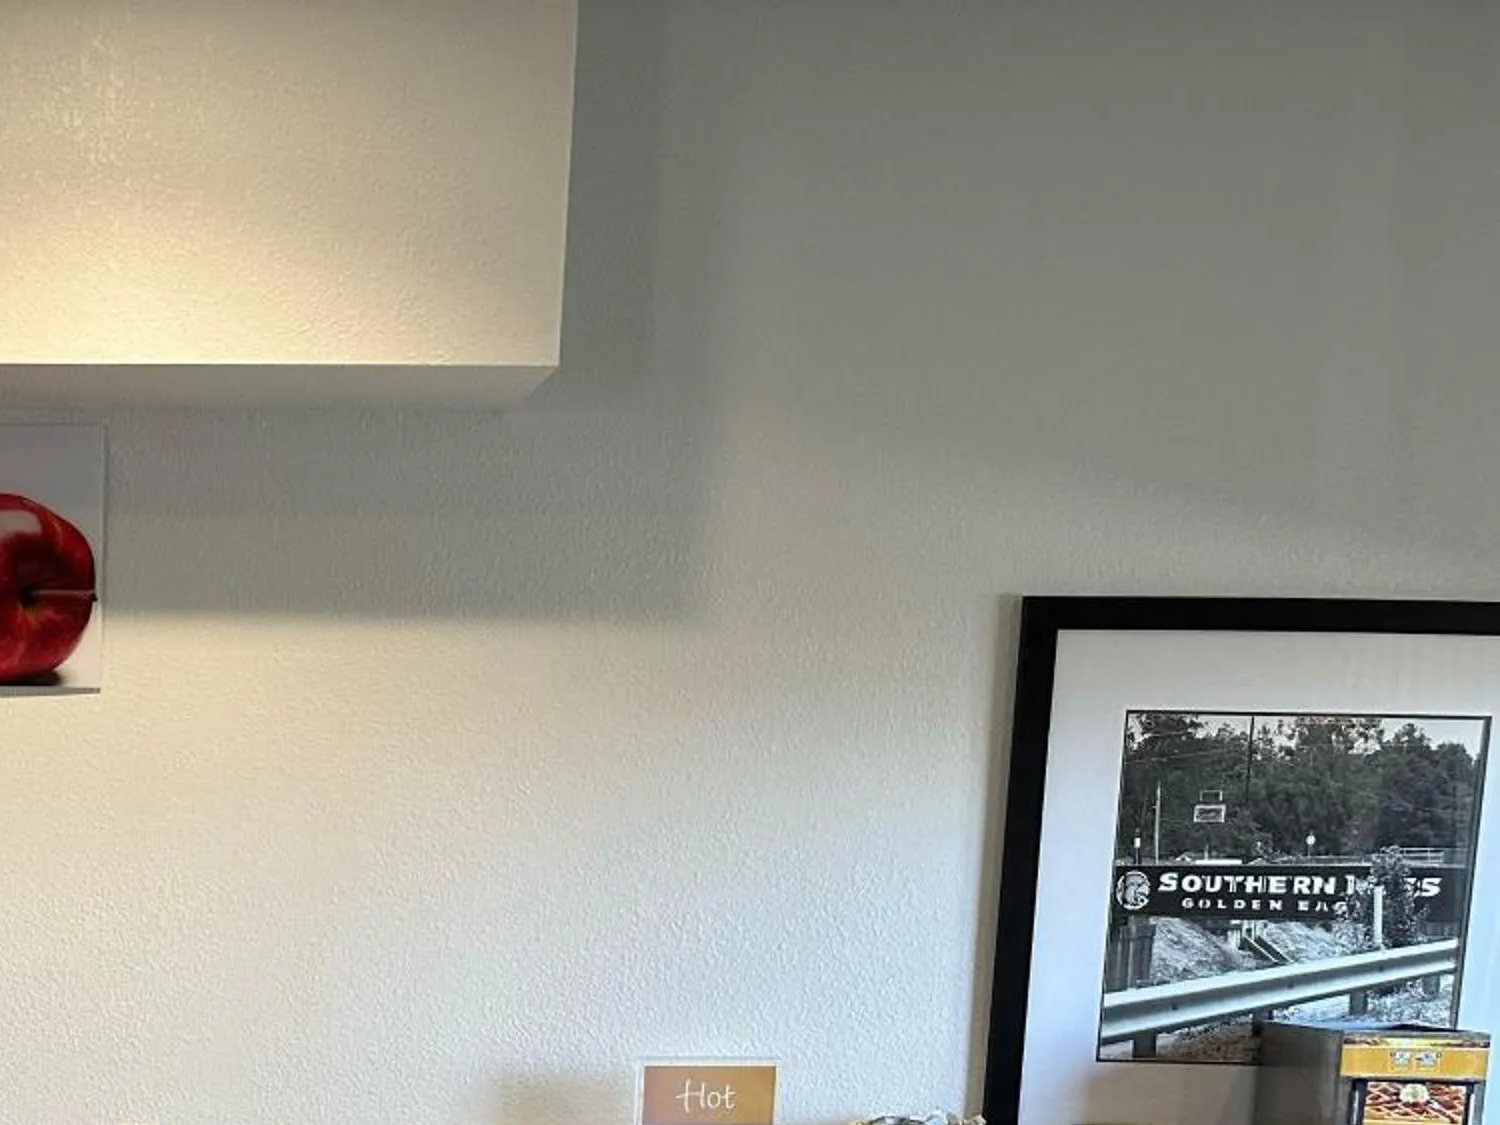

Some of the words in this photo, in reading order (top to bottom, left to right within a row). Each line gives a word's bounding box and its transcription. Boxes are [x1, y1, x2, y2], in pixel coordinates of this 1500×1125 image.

[1157, 872, 1337, 895] SOUTHERN
[1181, 898, 1283, 912] GOLDEN
[675, 1078, 737, 1115] Hot
